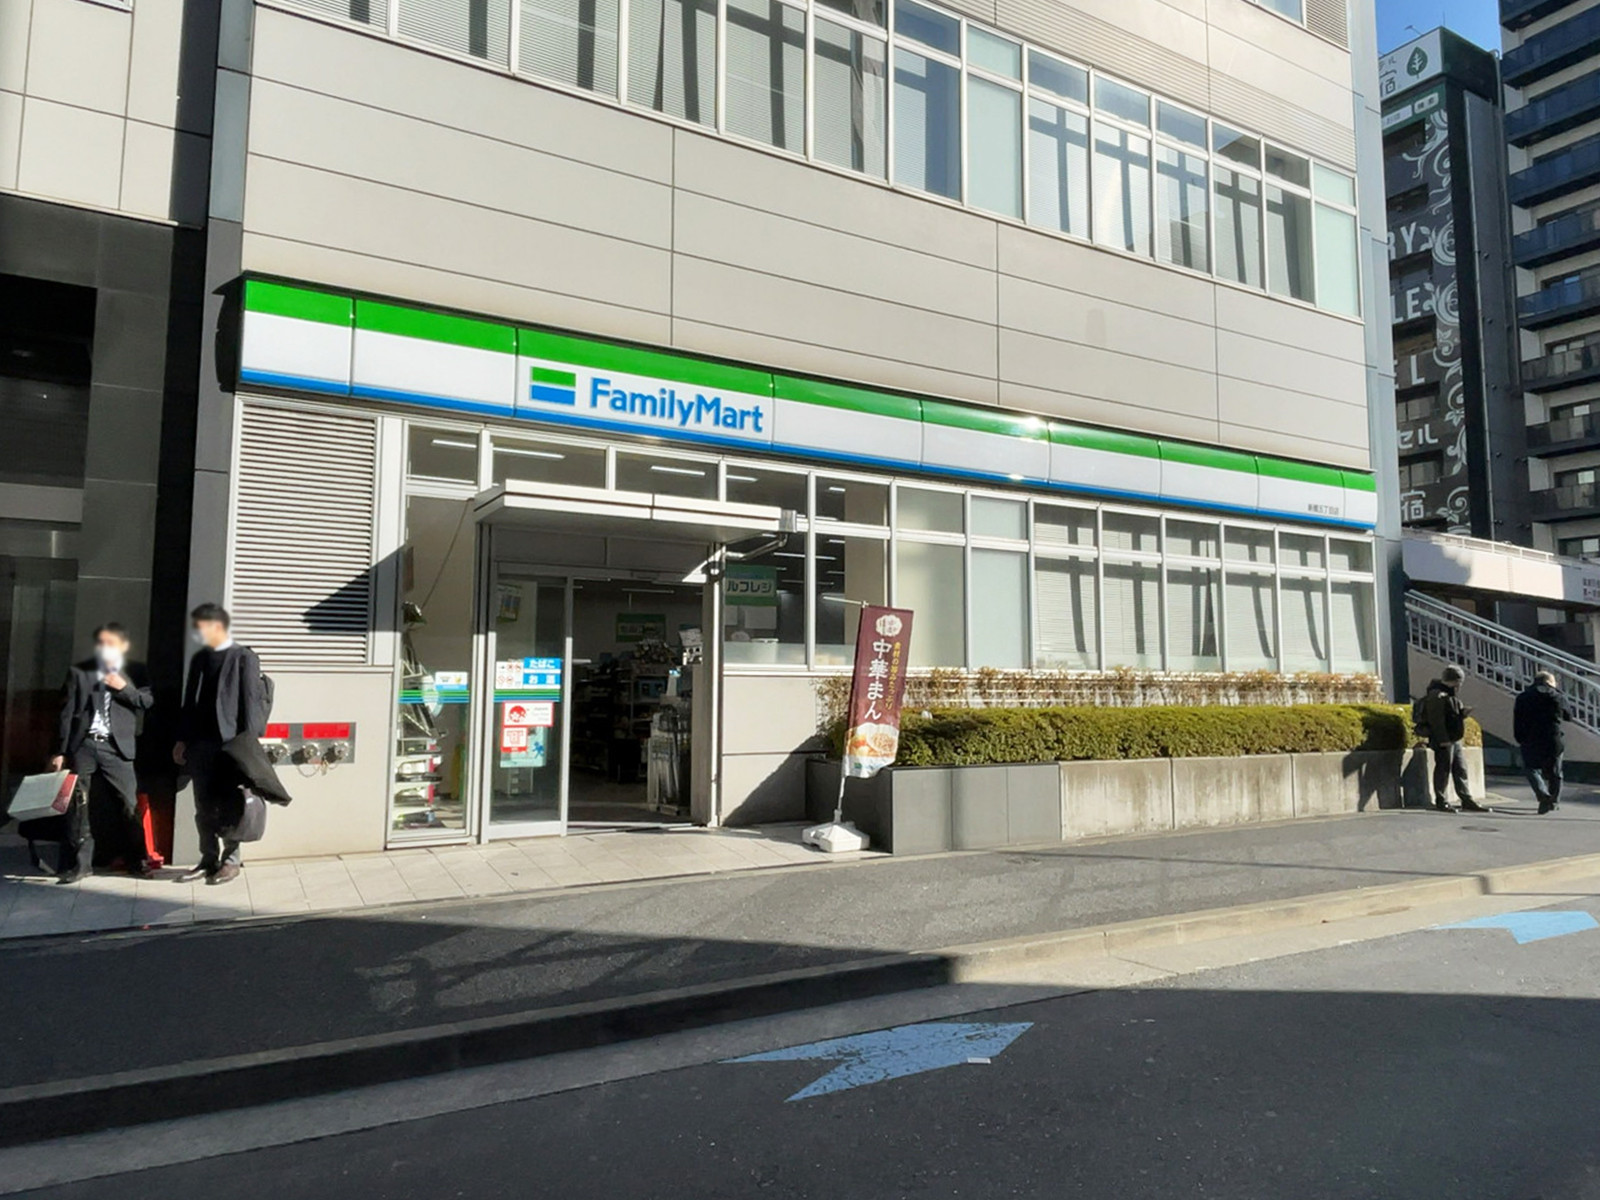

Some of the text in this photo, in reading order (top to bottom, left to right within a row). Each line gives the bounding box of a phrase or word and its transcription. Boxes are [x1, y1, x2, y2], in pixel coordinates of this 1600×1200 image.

[590, 377, 763, 432] FamilyMart
[1401, 489, 1426, 522] 宿
[864, 638, 892, 720] 中華まん
